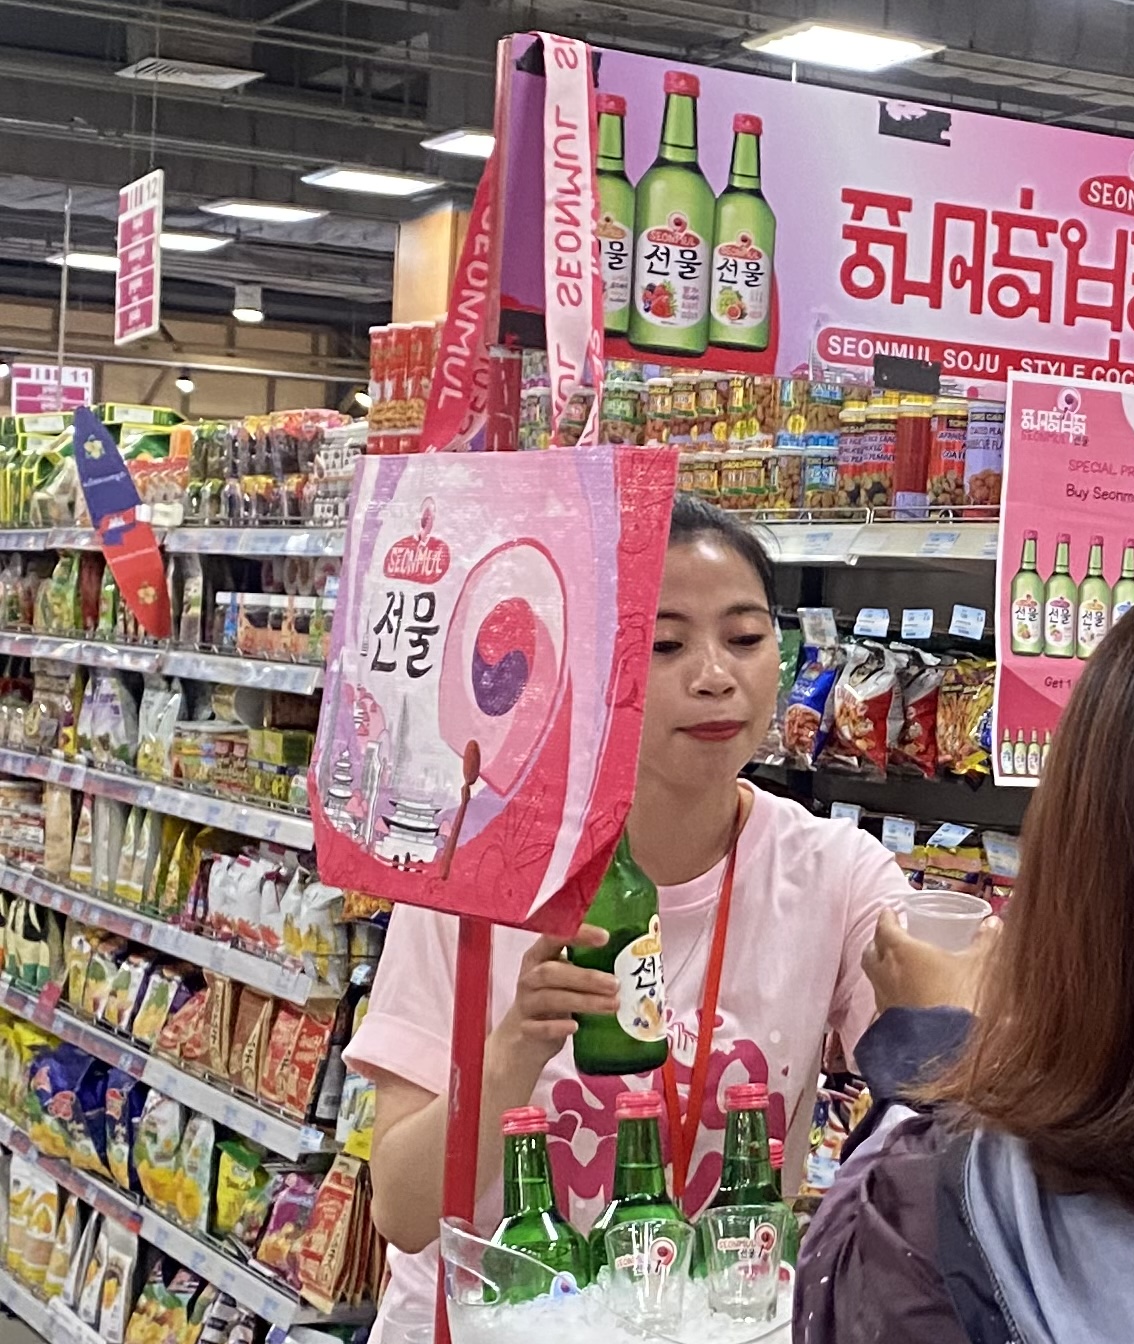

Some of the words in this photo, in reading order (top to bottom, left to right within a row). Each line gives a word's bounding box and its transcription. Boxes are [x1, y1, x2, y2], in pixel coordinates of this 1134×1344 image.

[942, 348, 1001, 375] SOJU
[1068, 459, 1117, 476] SPECIAL
[1066, 483, 1089, 501] Buy
[1044, 676, 1064, 690] Get
[630, 953, 664, 990] 선
